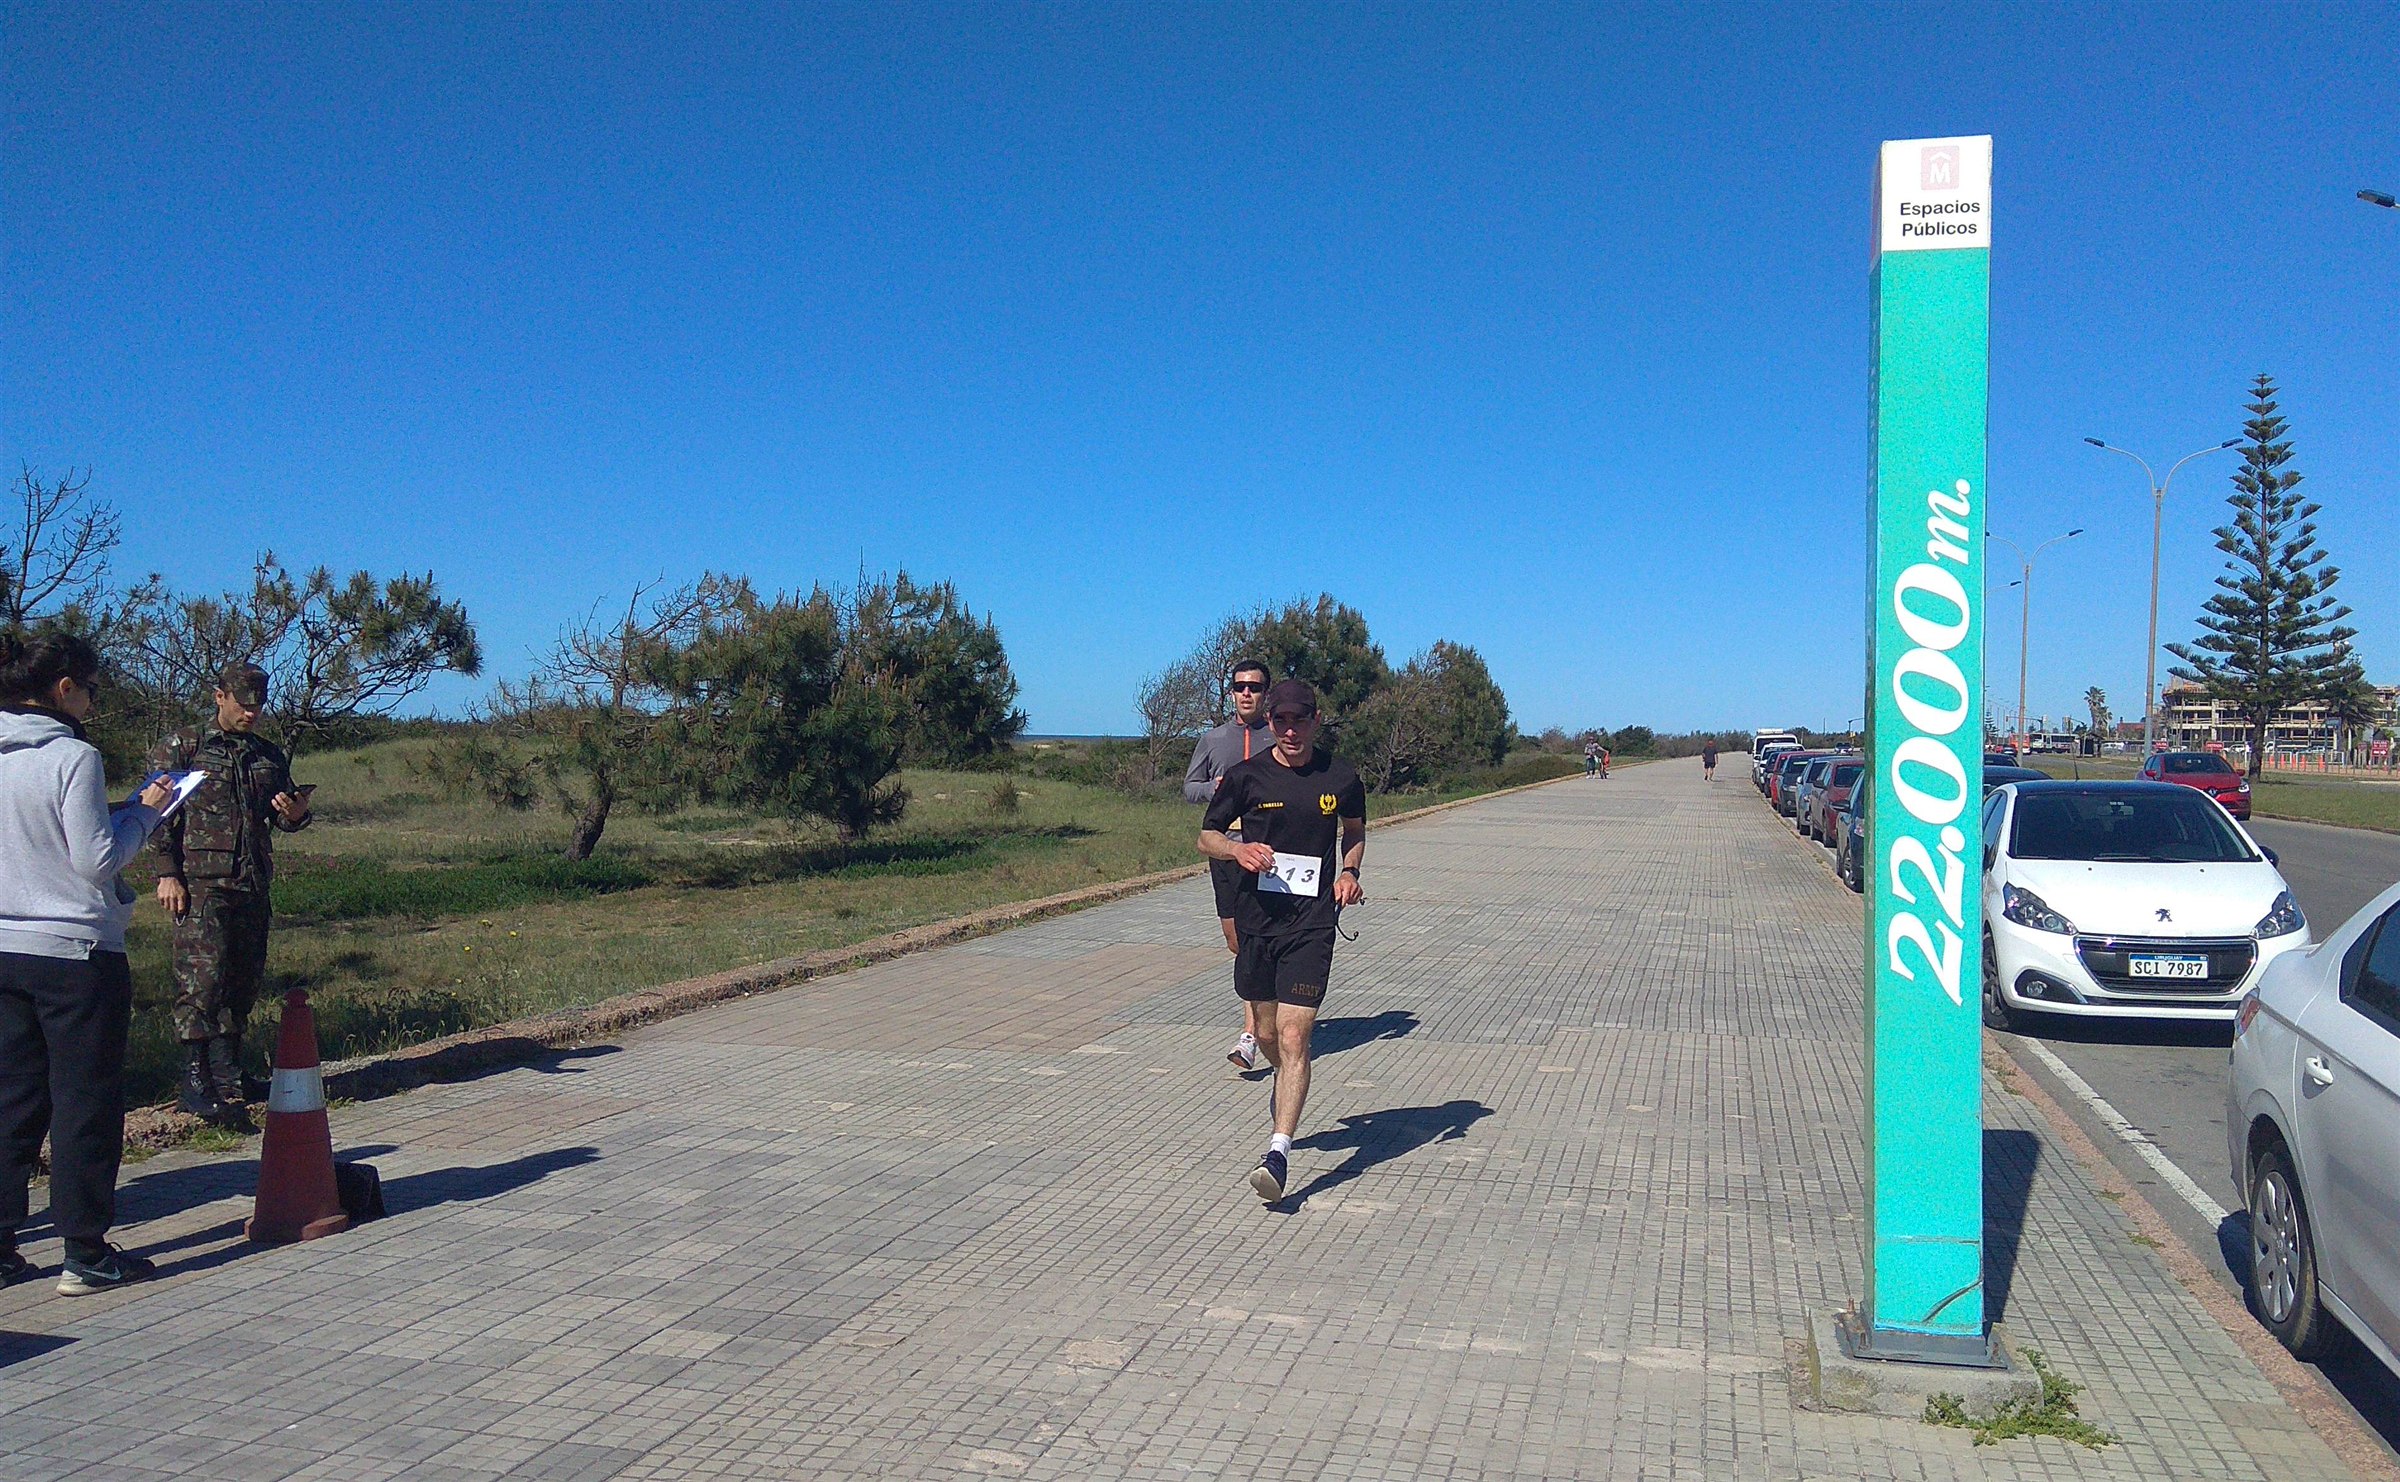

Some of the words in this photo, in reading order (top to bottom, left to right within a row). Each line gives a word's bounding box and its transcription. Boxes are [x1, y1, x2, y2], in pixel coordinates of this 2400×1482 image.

[1900, 200, 1980, 218] Espacios
[1902, 221, 1977, 237] Públicos
[2134, 961, 2160, 975] SCI
[2167, 962, 2203, 976] 7987
[1291, 982, 1320, 997] ARMY
